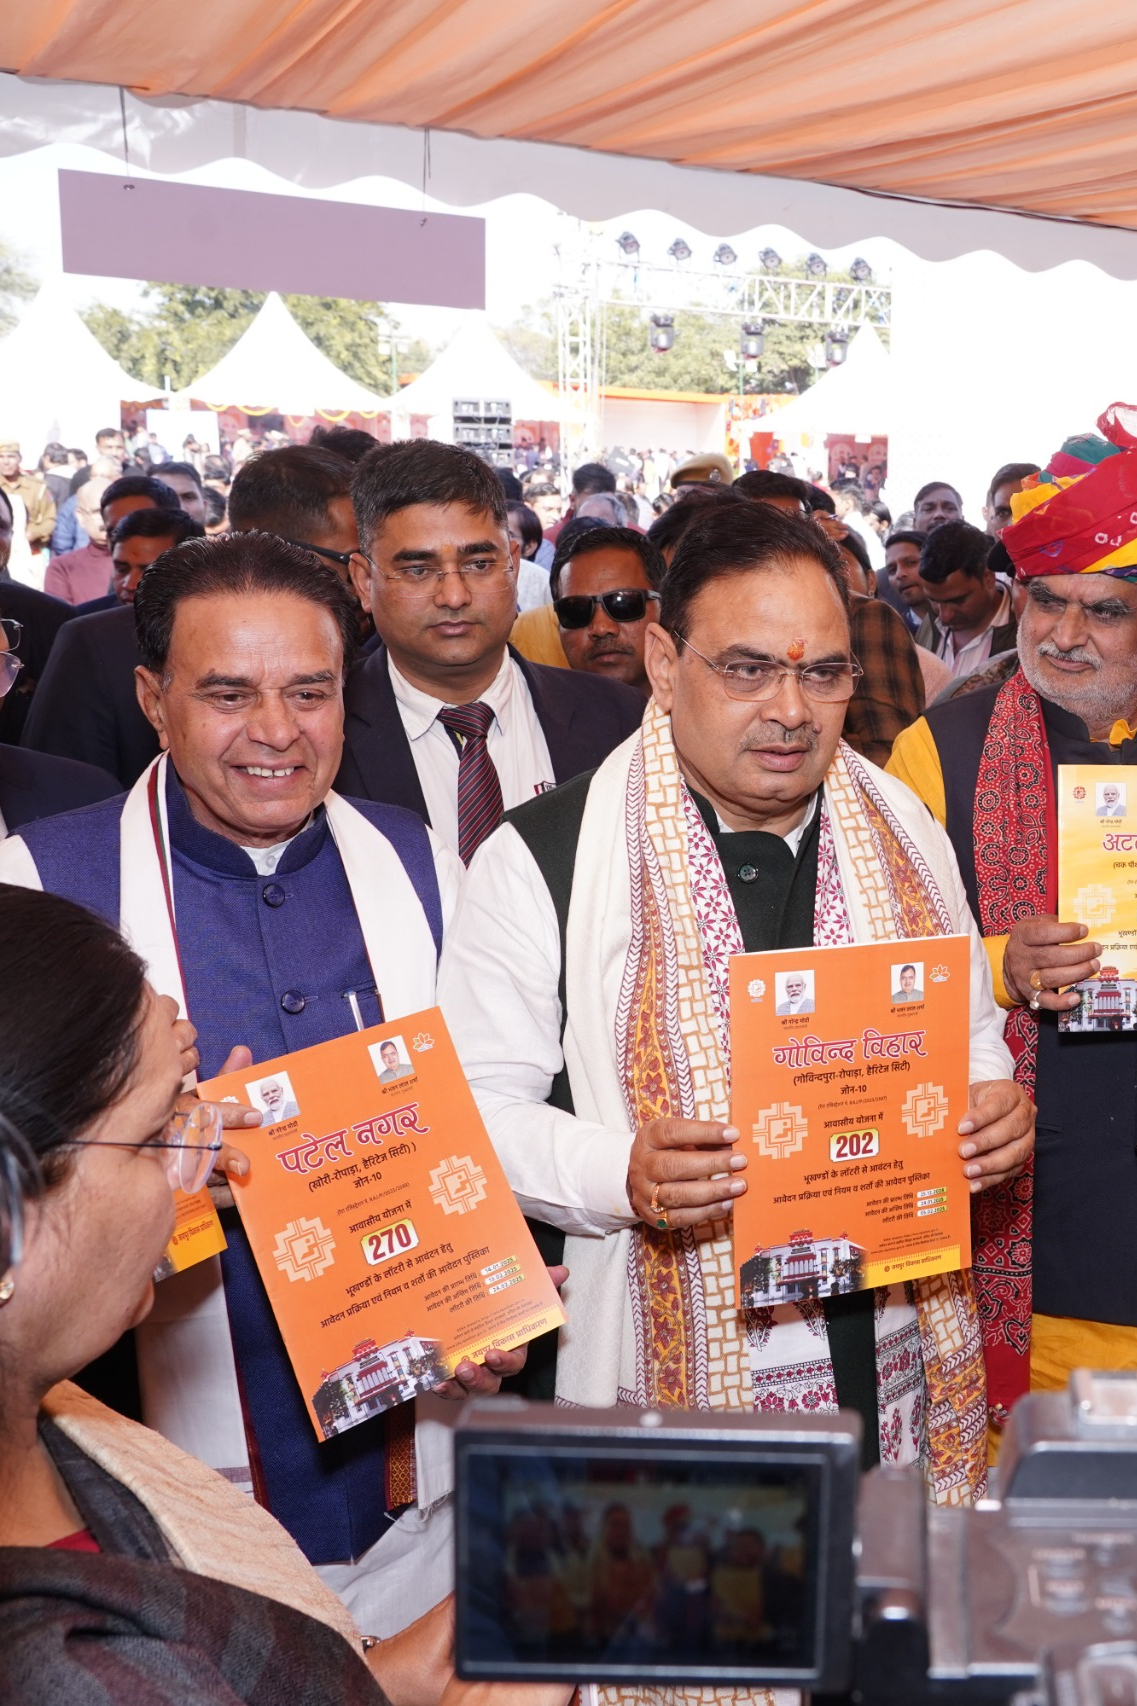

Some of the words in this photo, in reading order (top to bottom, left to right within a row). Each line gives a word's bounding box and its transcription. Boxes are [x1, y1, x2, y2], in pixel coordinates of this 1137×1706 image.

[773, 1035, 857, 1068] गोविन्द
[863, 1029, 927, 1059] विहार
[866, 1062, 889, 1076] हैरिटेज
[891, 1060, 911, 1074] सिटी)
[840, 1084, 867, 1095] जोन-10
[824, 1116, 856, 1128] आवासीय
[856, 1114, 876, 1124] योजना
[276, 1130, 354, 1174] पटेल
[353, 1102, 430, 1145] नगर
[836, 1132, 874, 1158] 202
[362, 1151, 388, 1170] हैरिटेज
[388, 1144, 411, 1162] सिटी)
[353, 1172, 382, 1189] जोन-10
[804, 1170, 829, 1184] भूखण्डों
[831, 1170, 838, 1178] के
[840, 1166, 860, 1177] लॉटरी
[870, 1162, 892, 1173] आवंटन
[893, 1160, 903, 1170] हेतु
[773, 1194, 796, 1204] आवेदन
[798, 1189, 821, 1200] प्रक्रिया
[823, 1188, 833, 1198] एवं
[834, 1186, 852, 1196] नियम
[860, 1181, 874, 1192] शर्तों
[875, 1180, 884, 1189] की
[885, 1176, 906, 1188] आवेदन
[908, 1172, 931, 1186] पुस्तिका
[349, 1214, 381, 1234] आवासीय
[384, 1204, 404, 1220] योजना
[405, 1199, 413, 1209] में
[368, 1223, 412, 1260] 270
[345, 1276, 372, 1298] भूखण्डों
[373, 1272, 382, 1283] के
[384, 1262, 404, 1278] लॉटरी
[407, 1259, 413, 1268] से
[415, 1248, 439, 1264] आवंटन
[440, 1242, 454, 1254] हेतु
[321, 1312, 346, 1328] आवेदन
[346, 1299, 370, 1316] प्रक्रिया
[371, 1292, 383, 1305] एवं
[384, 1285, 402, 1300] नियम
[404, 1282, 410, 1291] व
[412, 1273, 426, 1288] शर्तों
[427, 1268, 437, 1279] की
[438, 1258, 462, 1274] आवेदन
[464, 1246, 490, 1264] पुस्तिका
[424, 1290, 441, 1302] आवेदन
[442, 1286, 450, 1294] की
[426, 1300, 444, 1312] आवेदन
[445, 1294, 453, 1304] की
[449, 1302, 465, 1313] लॉटरी
[466, 1297, 473, 1306] की
[471, 1345, 491, 1358] जयपर
[492, 1334, 515, 1348] विकास
[516, 1318, 547, 1337] प्राधिकरण
